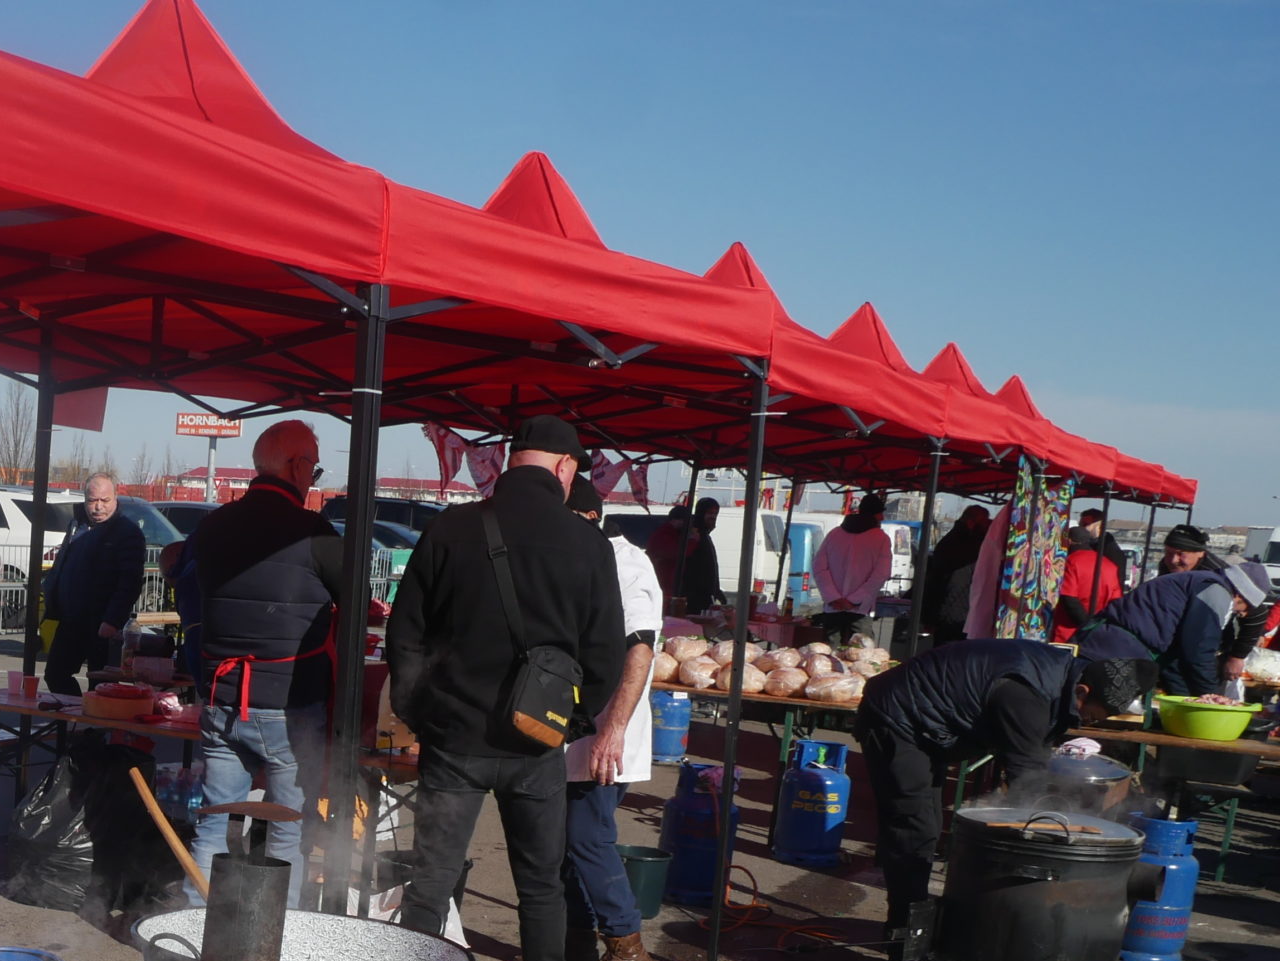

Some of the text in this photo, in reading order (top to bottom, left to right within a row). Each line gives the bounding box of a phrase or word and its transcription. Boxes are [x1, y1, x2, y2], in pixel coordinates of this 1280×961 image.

[178, 415, 240, 427] HORNBACH
[799, 790, 839, 802] GAS
[792, 801, 841, 813] PECO
